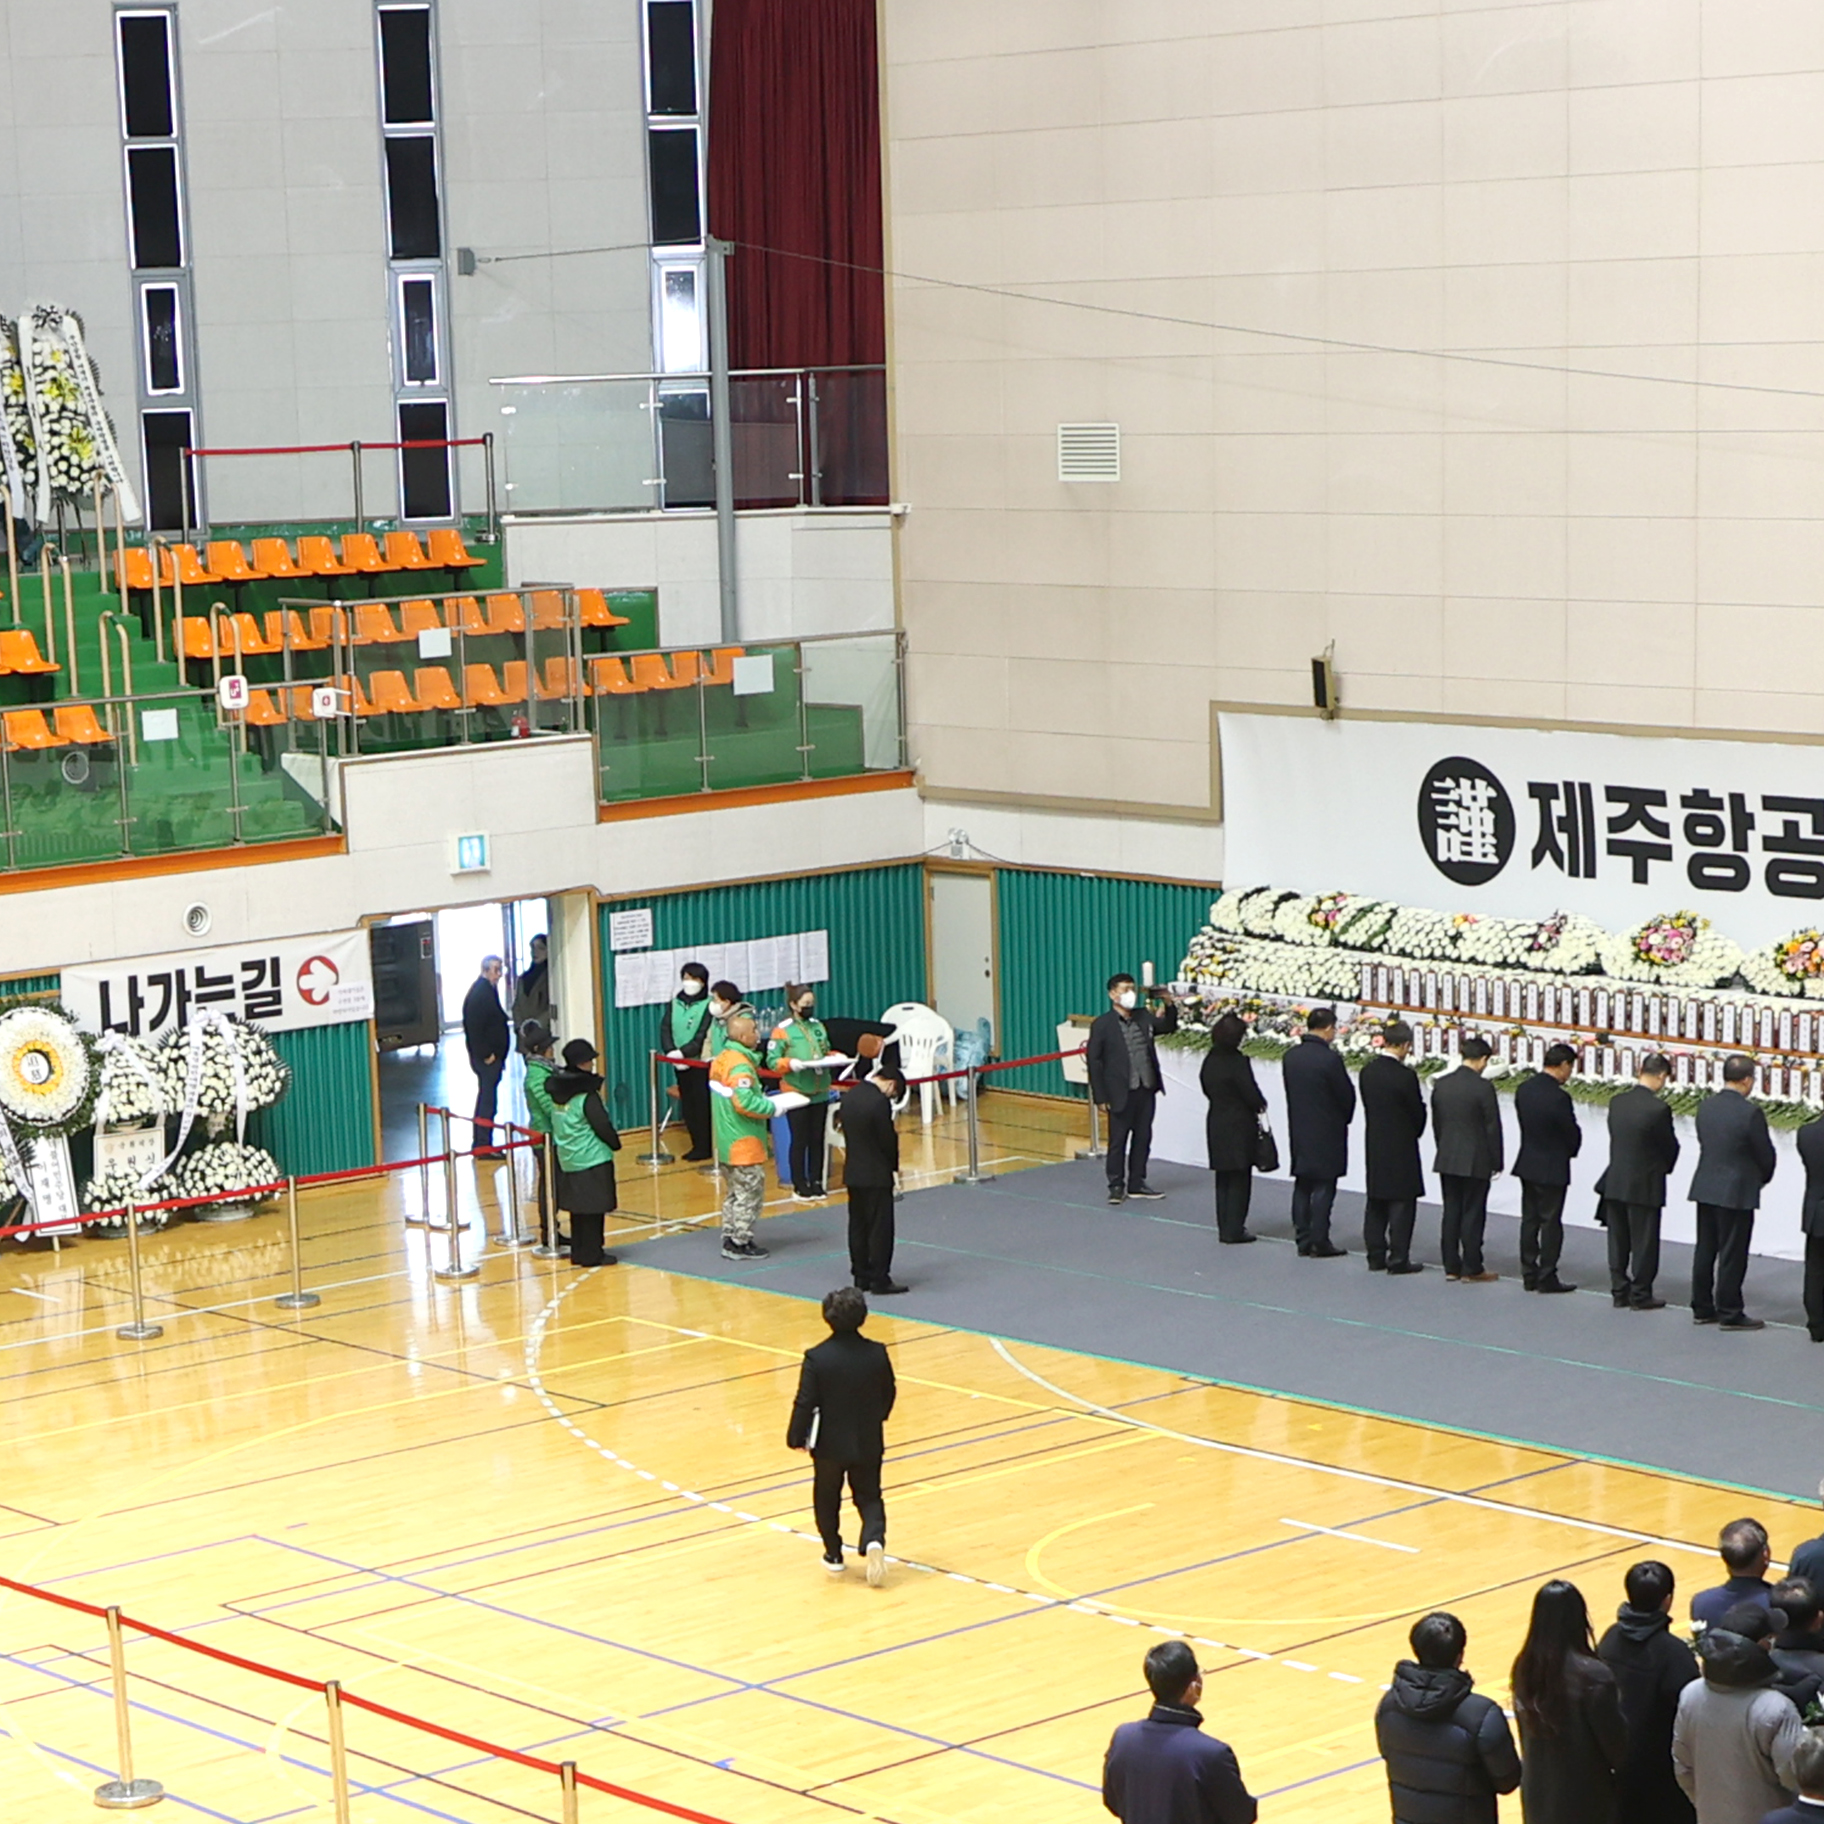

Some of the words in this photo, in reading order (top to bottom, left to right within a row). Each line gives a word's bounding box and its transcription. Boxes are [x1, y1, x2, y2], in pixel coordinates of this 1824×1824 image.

[99, 957, 283, 1037] 나가는길
[36, 1160, 53, 1205] 이재명
[105, 1153, 157, 1170] 우원식
